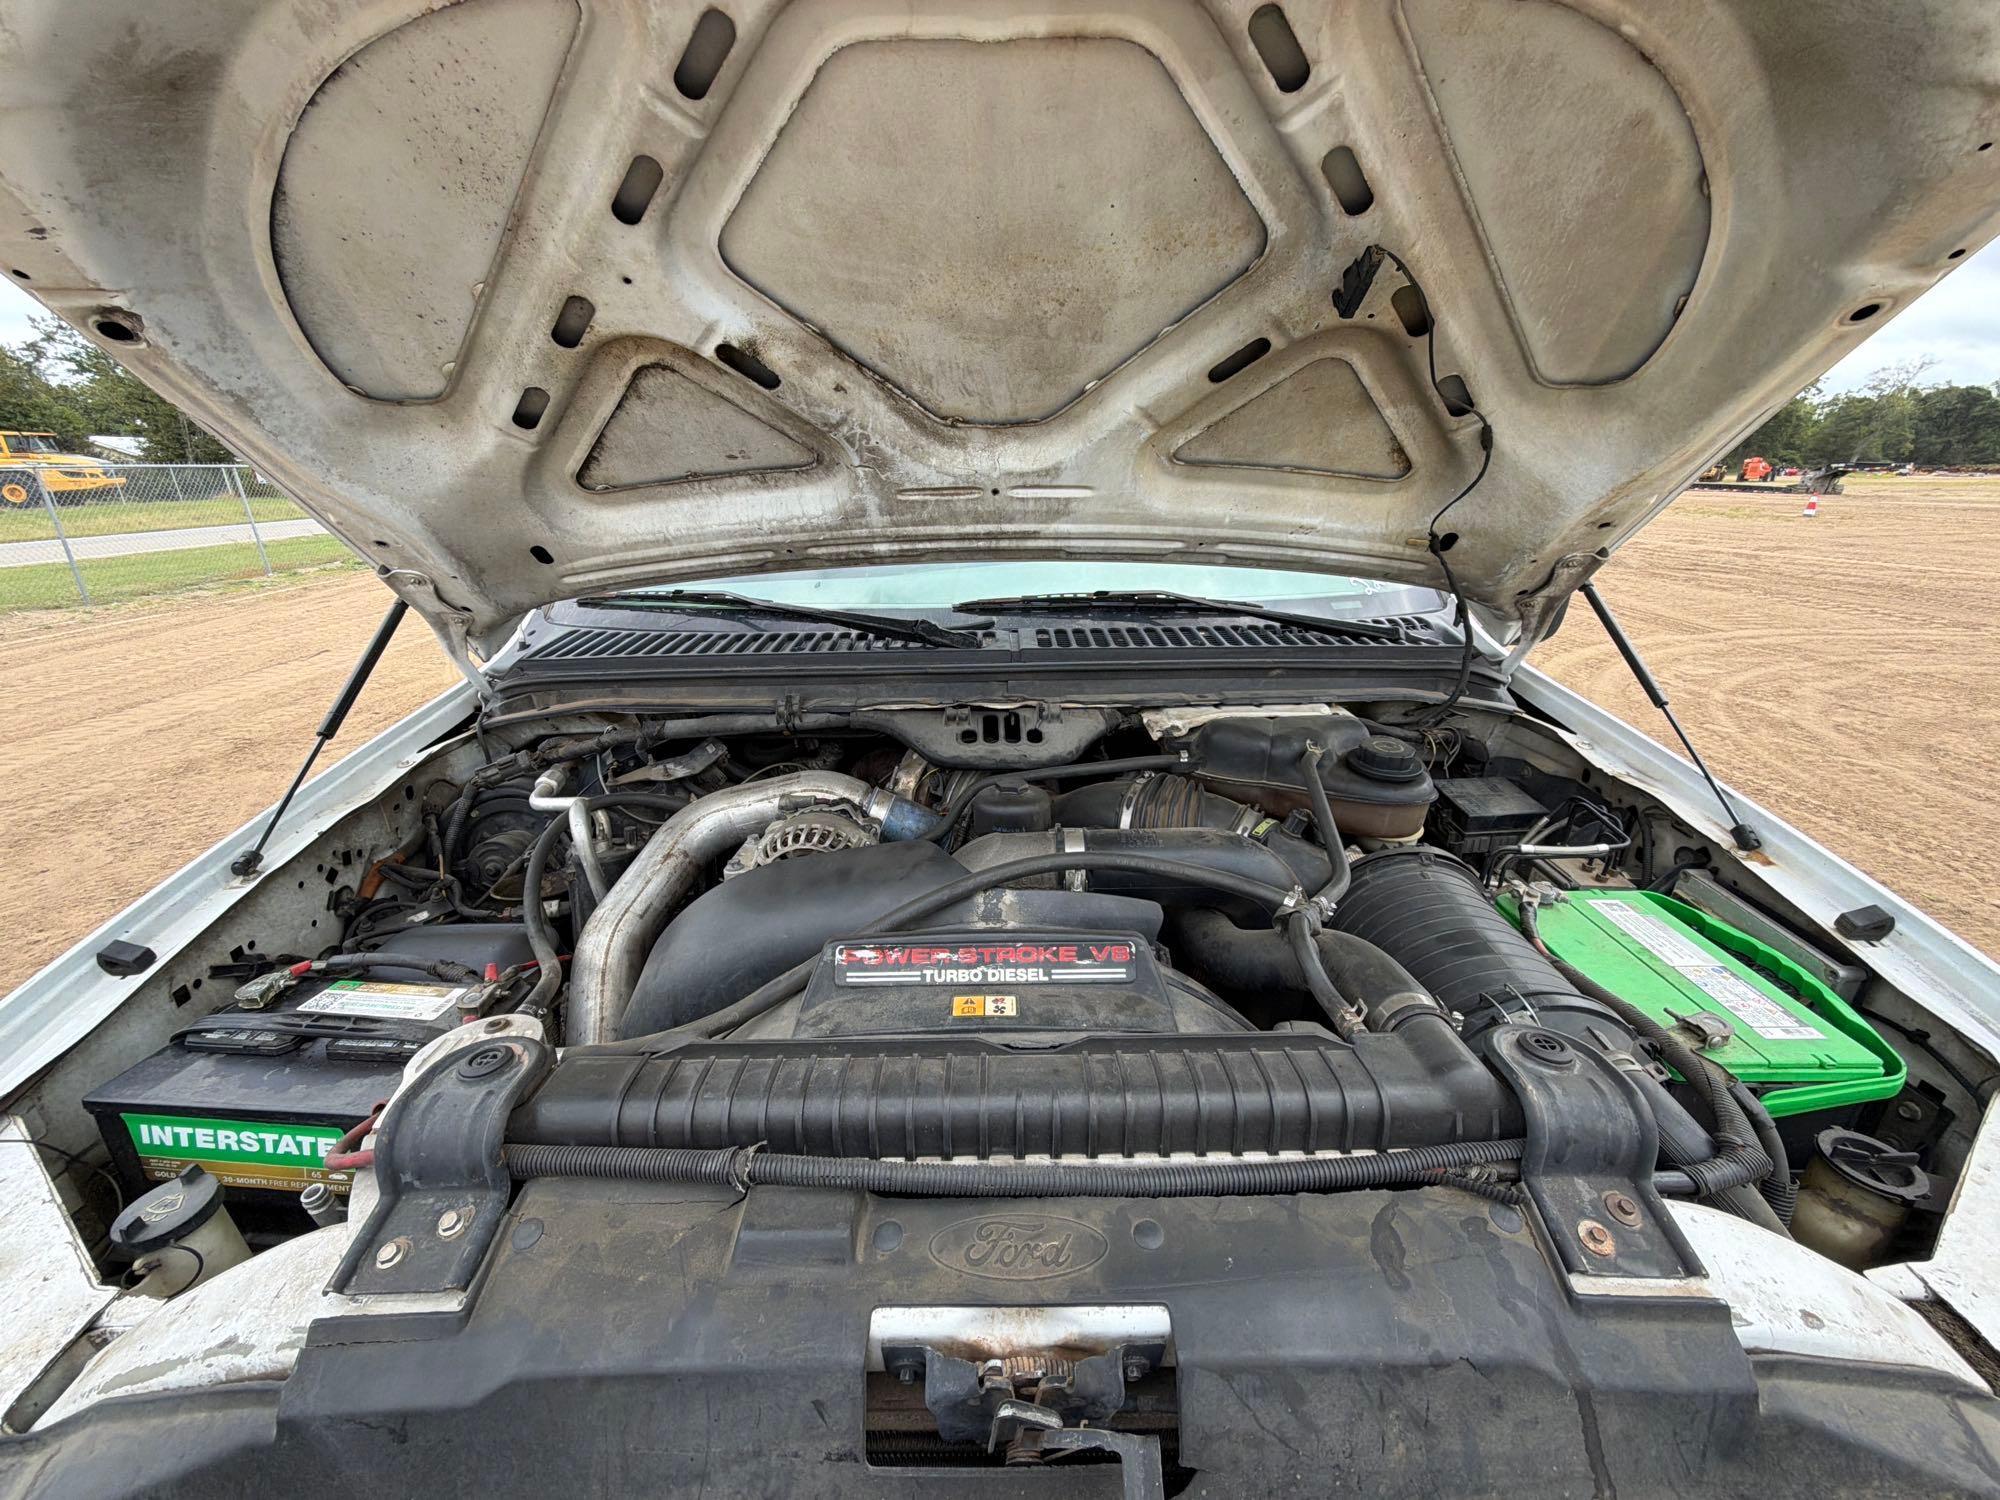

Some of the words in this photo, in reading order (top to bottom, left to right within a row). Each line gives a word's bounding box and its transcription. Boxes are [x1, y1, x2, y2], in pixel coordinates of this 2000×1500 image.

[958, 946, 1078, 964] STROKE
[1089, 945, 1131, 962] V8
[922, 968, 983, 983] TURBO
[987, 967, 1049, 982] DIESEL
[140, 1124, 337, 1157] INTERSTATE
[154, 1170, 177, 1178] GOLD
[269, 1180, 289, 1188] FREE
[964, 1221, 1073, 1268] Ford
